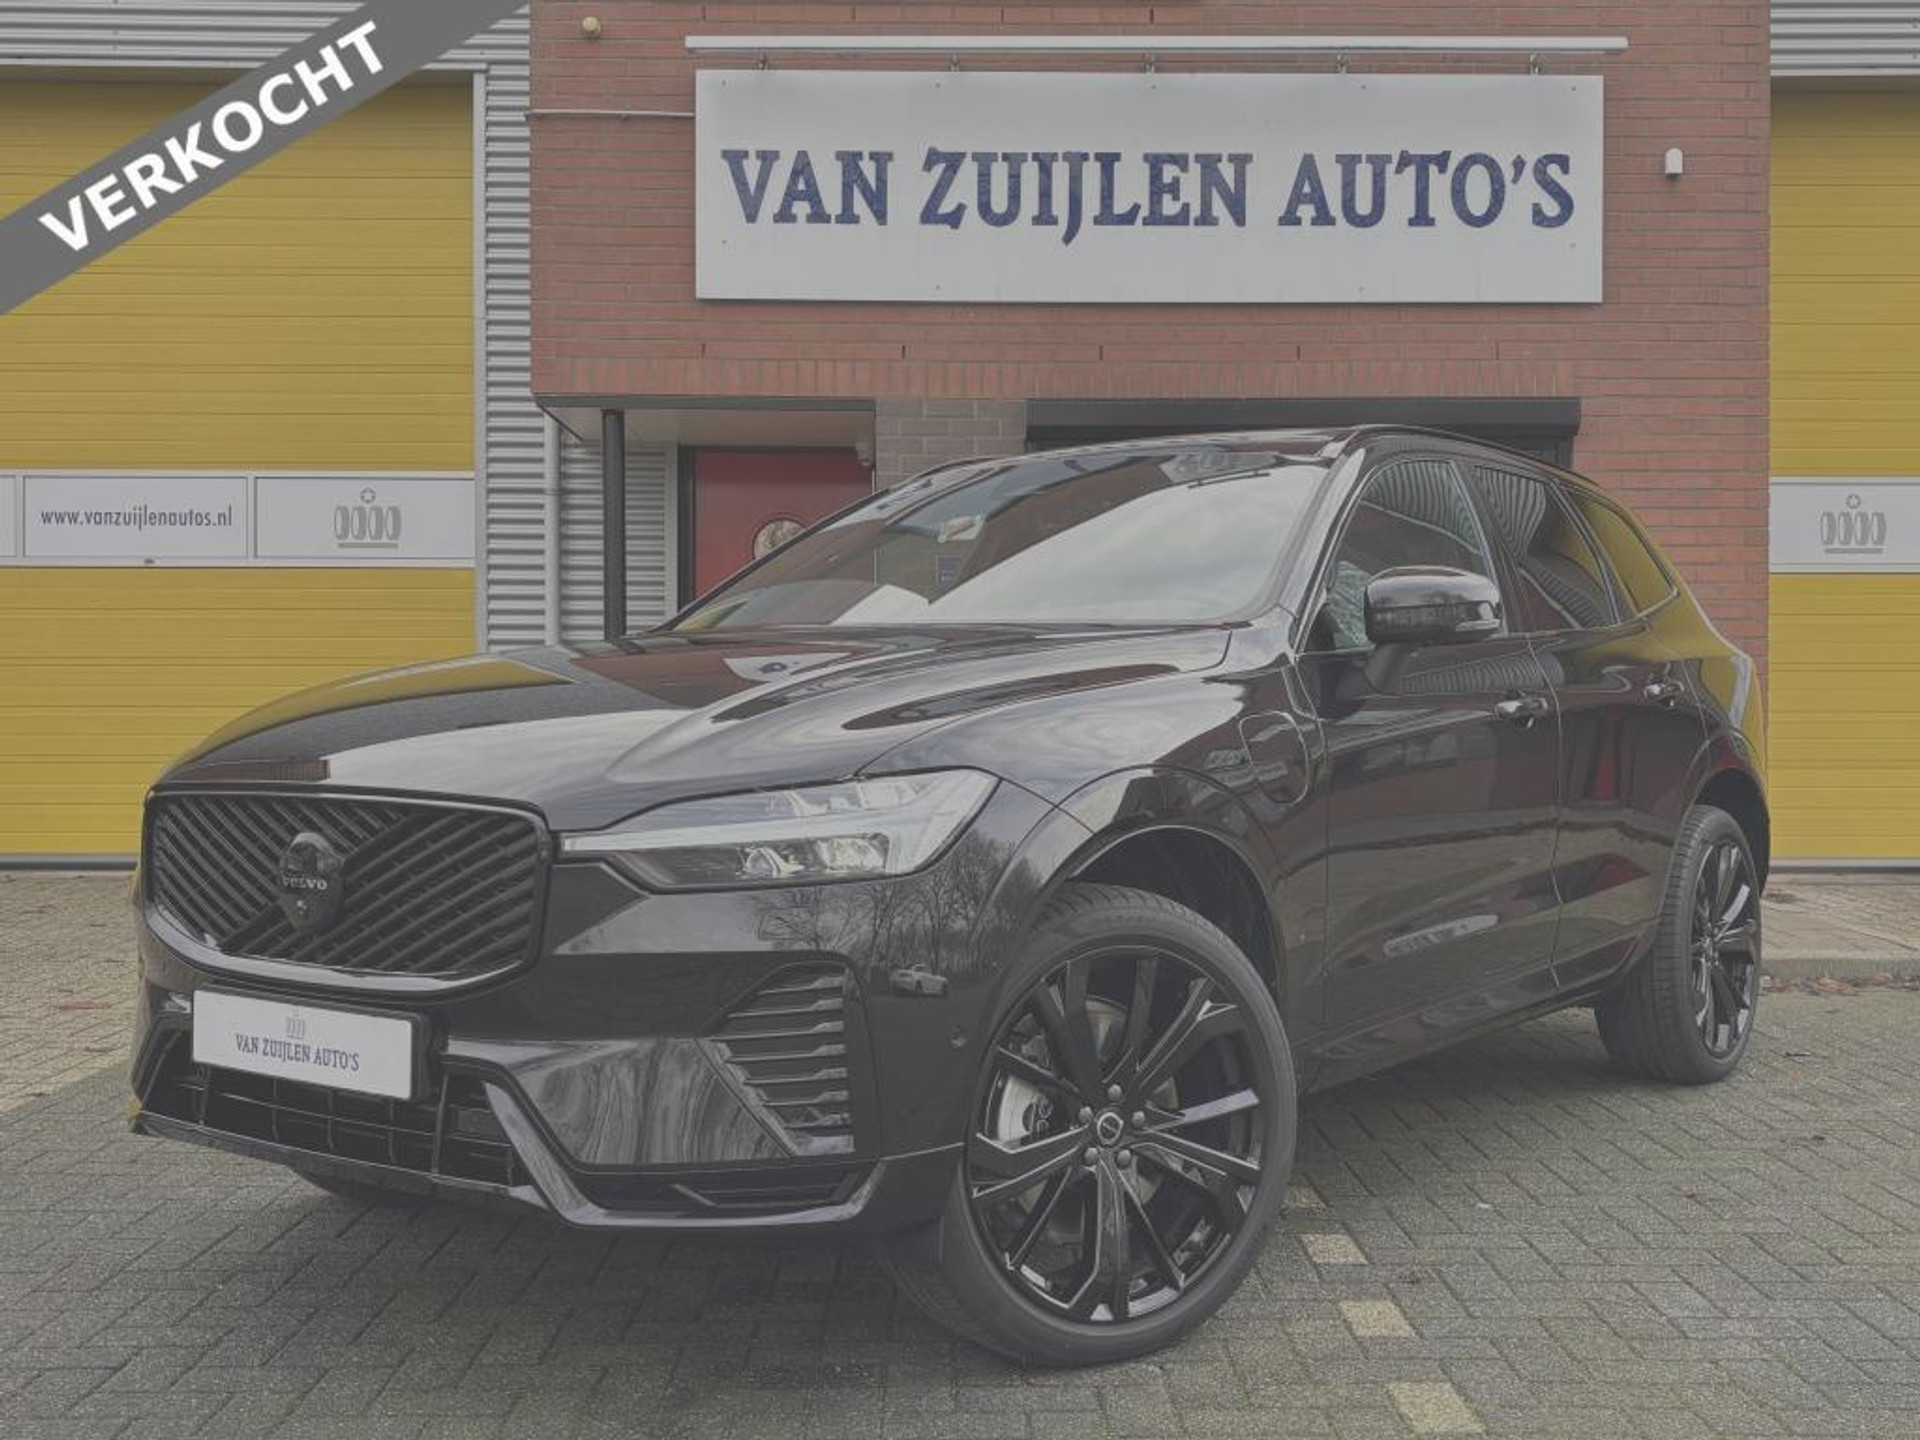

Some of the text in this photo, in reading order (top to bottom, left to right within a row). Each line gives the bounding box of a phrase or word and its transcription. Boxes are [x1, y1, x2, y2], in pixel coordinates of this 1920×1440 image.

[720, 147, 1575, 247] VAN ZUIJLEN AUTO'S
[41, 504, 232, 531] www.vanzuijlenautos.nl
[282, 876, 328, 891] VOLVO
[235, 1034, 360, 1072] VAN ZUIJLEN AUTO'S
